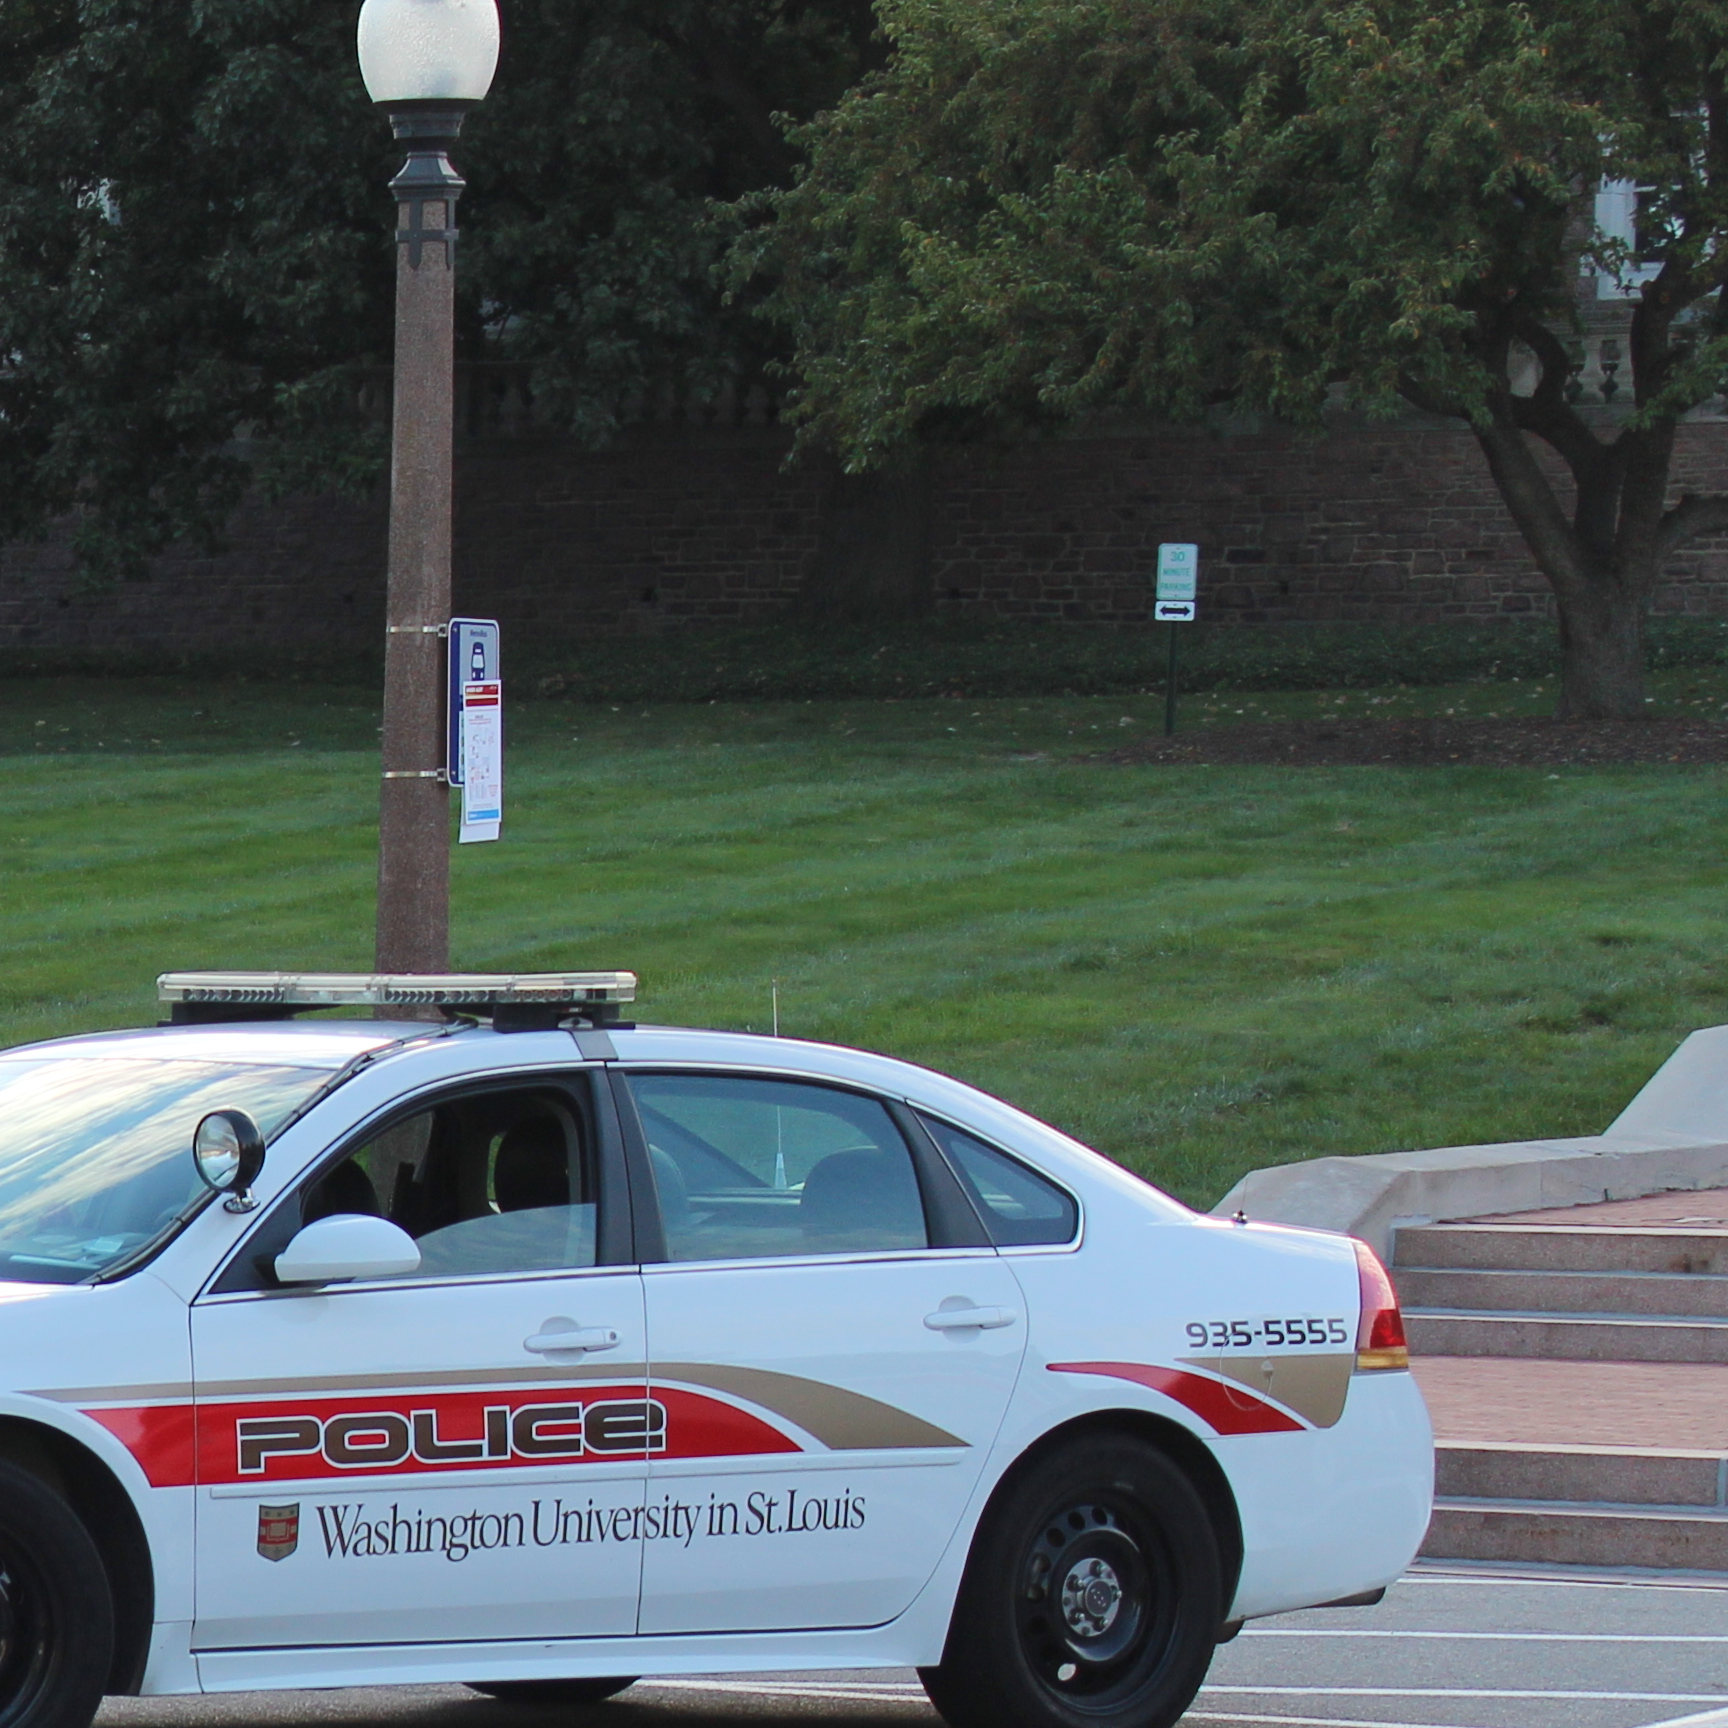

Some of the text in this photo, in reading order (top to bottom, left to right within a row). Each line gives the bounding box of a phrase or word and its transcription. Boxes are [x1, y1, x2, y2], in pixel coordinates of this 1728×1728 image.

[1170, 551, 1185, 562] 30
[1185, 1318, 1348, 1348] 935-5555
[237, 1398, 667, 1475] POLICE
[315, 1500, 526, 1562] Washington
[530, 1494, 702, 1550] University
[706, 1492, 739, 1536] in
